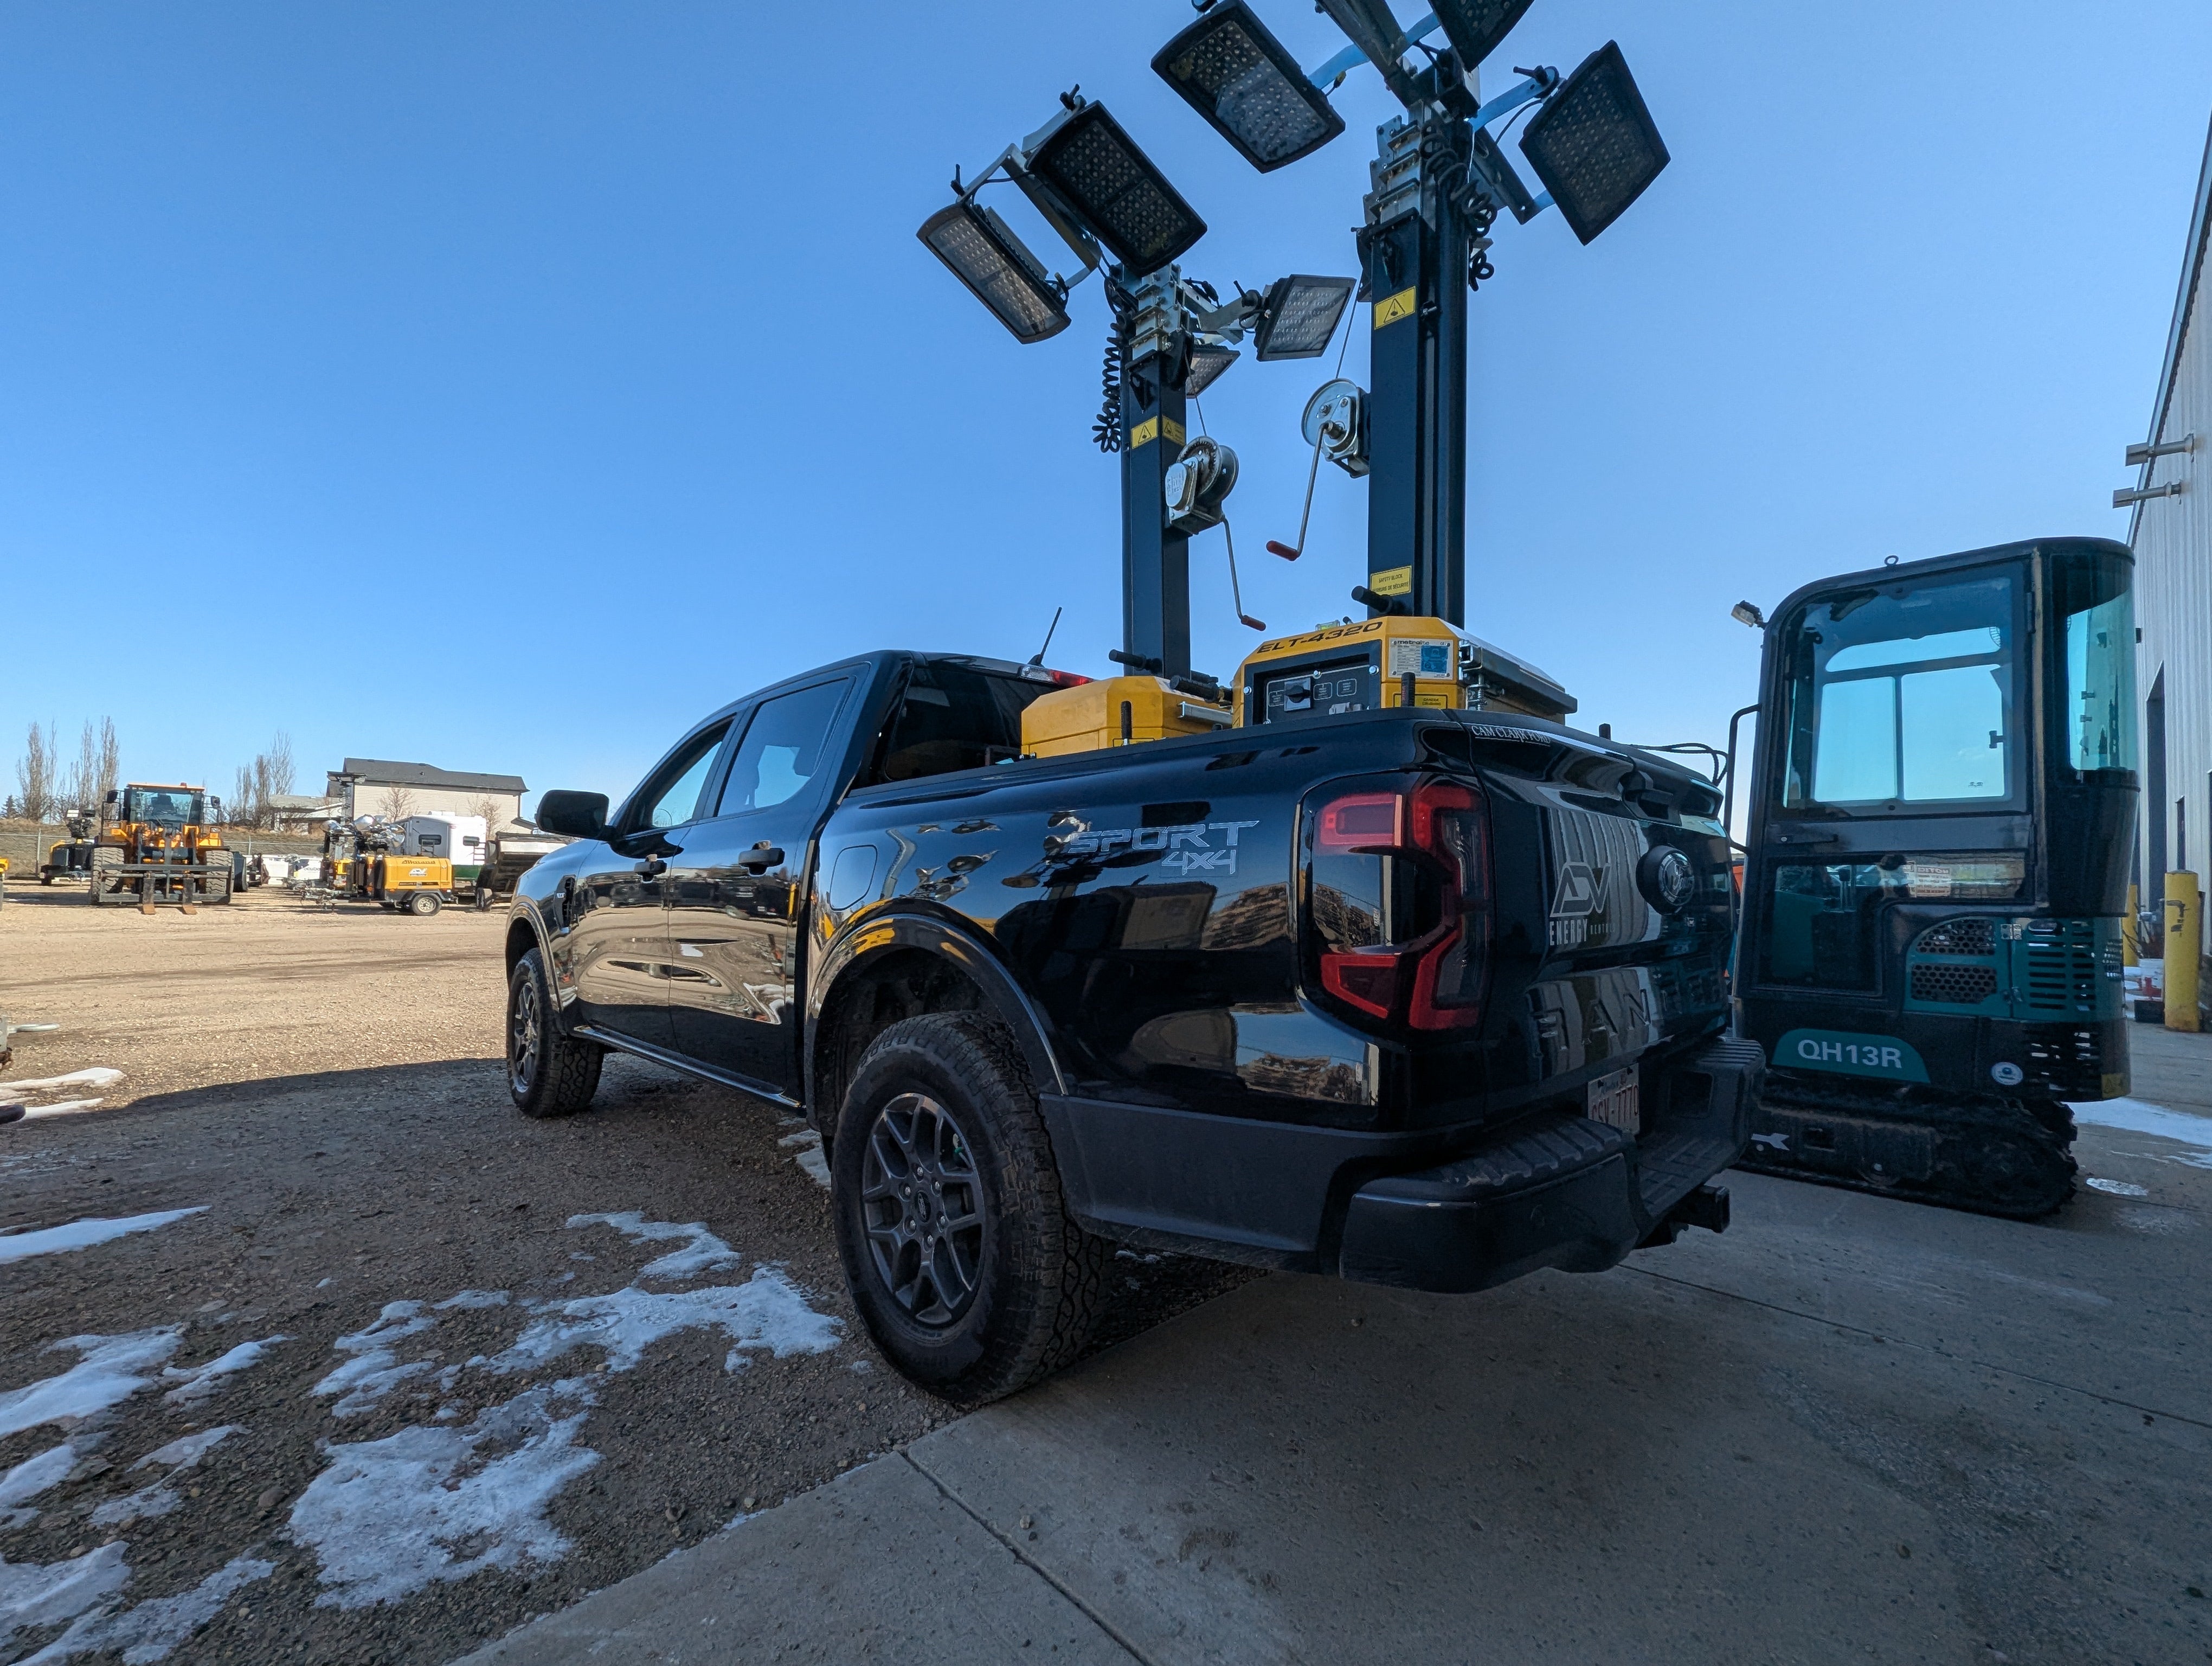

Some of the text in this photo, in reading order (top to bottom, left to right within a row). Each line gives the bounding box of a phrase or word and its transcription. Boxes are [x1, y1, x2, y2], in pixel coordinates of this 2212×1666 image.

[1257, 622, 1382, 653] ELT-4320
[1471, 725, 1551, 744] CAM CLARK FORD
[1068, 821, 1260, 854] SPORT
[1549, 919, 1588, 946] ENERGY
[1797, 1039, 1902, 1068] QH13R
